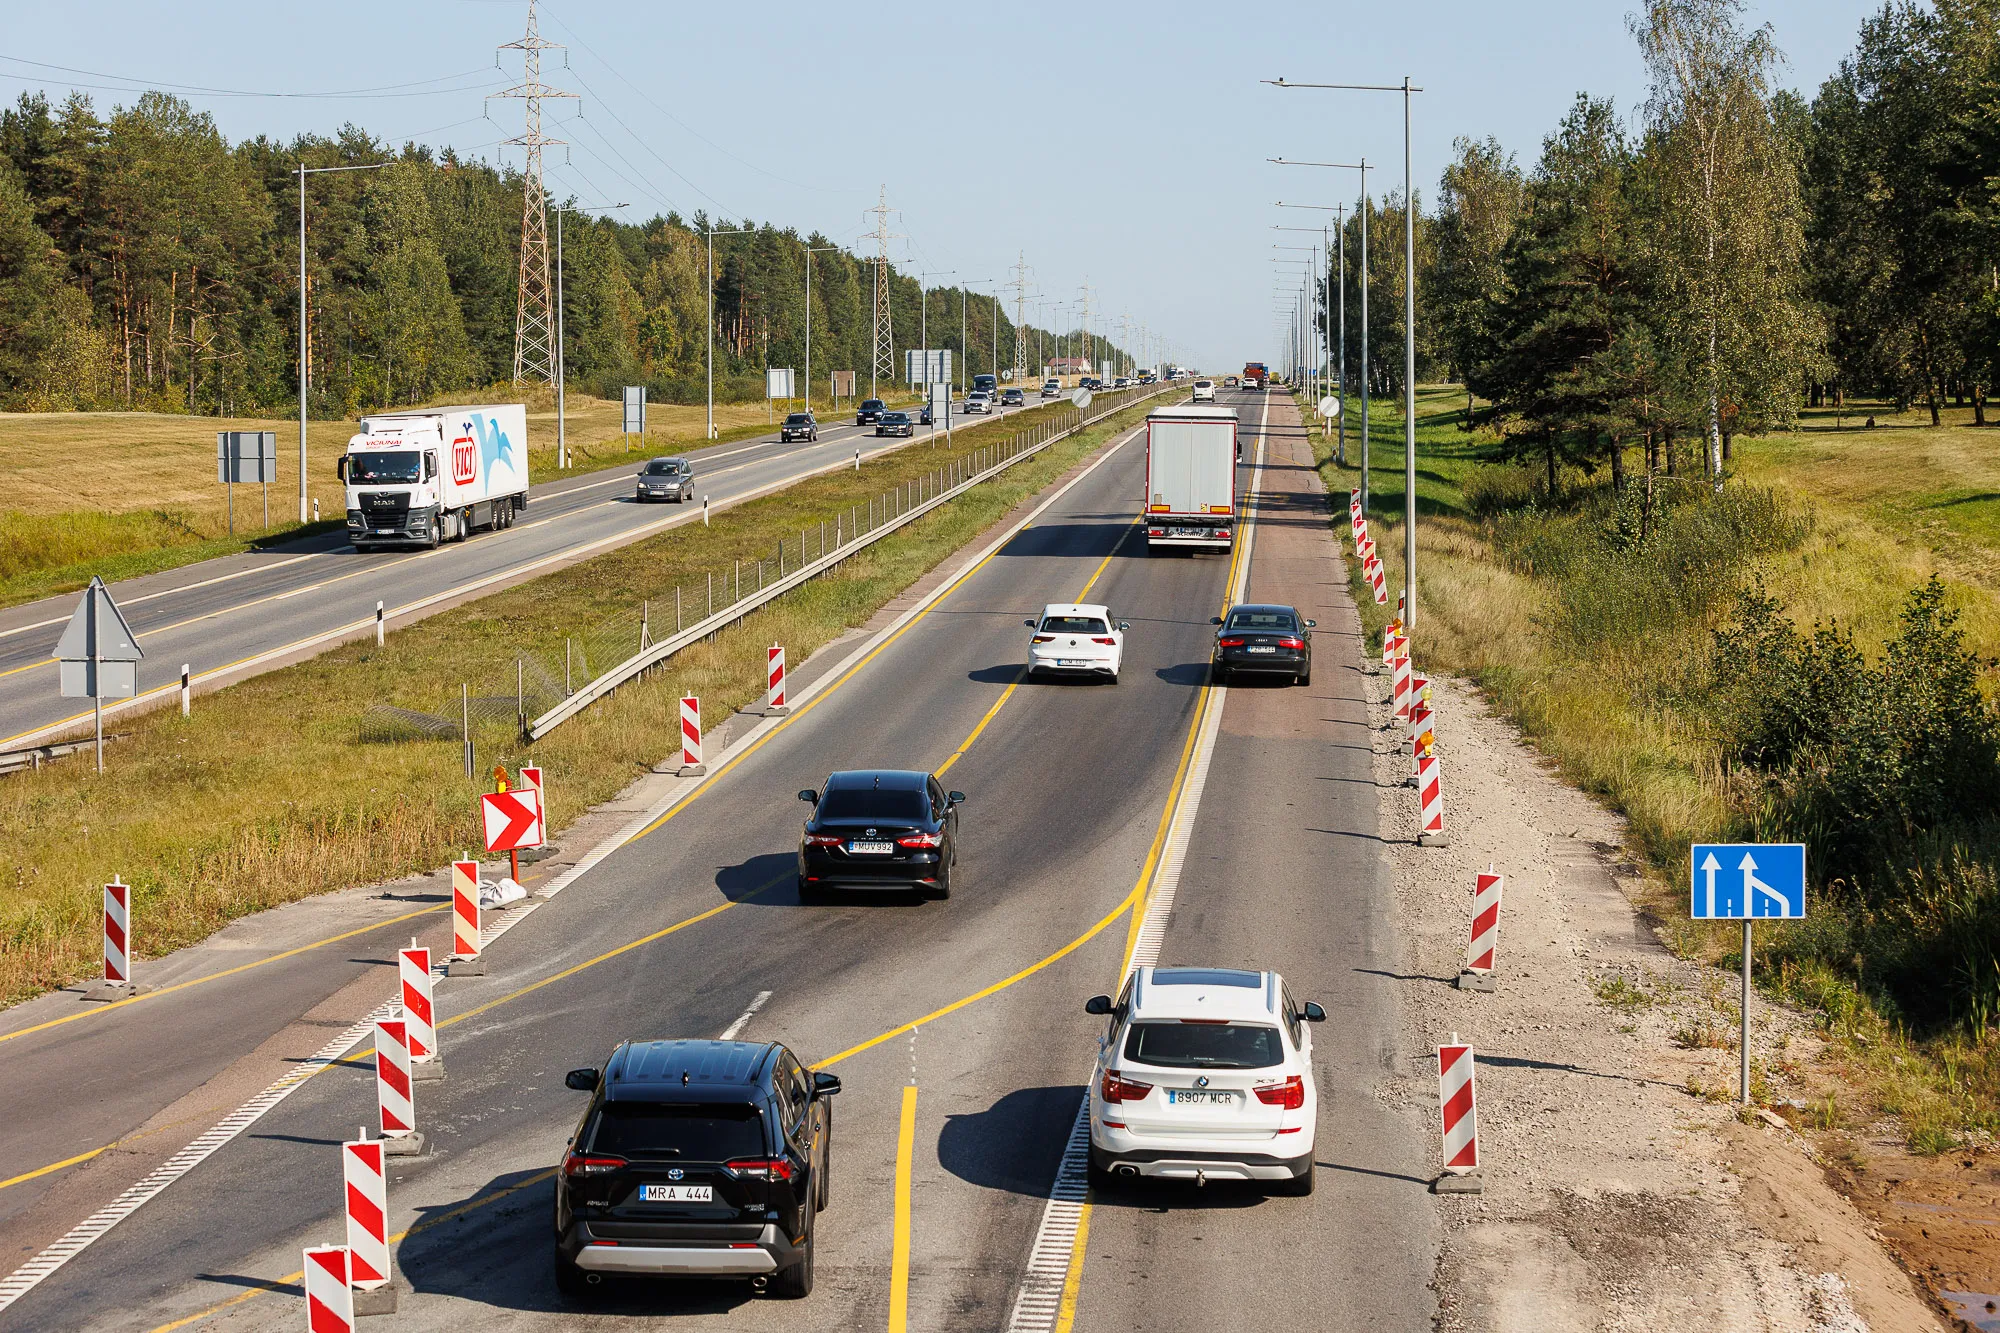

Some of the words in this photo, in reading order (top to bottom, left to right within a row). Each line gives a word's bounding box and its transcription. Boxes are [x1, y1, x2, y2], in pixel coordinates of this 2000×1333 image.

[858, 842, 876, 850] MUV
[876, 843, 892, 851] 992
[1177, 1092, 1207, 1103] 8907
[1210, 1093, 1232, 1104] MCR
[648, 1187, 676, 1200] MRA
[686, 1187, 710, 1200] 444
